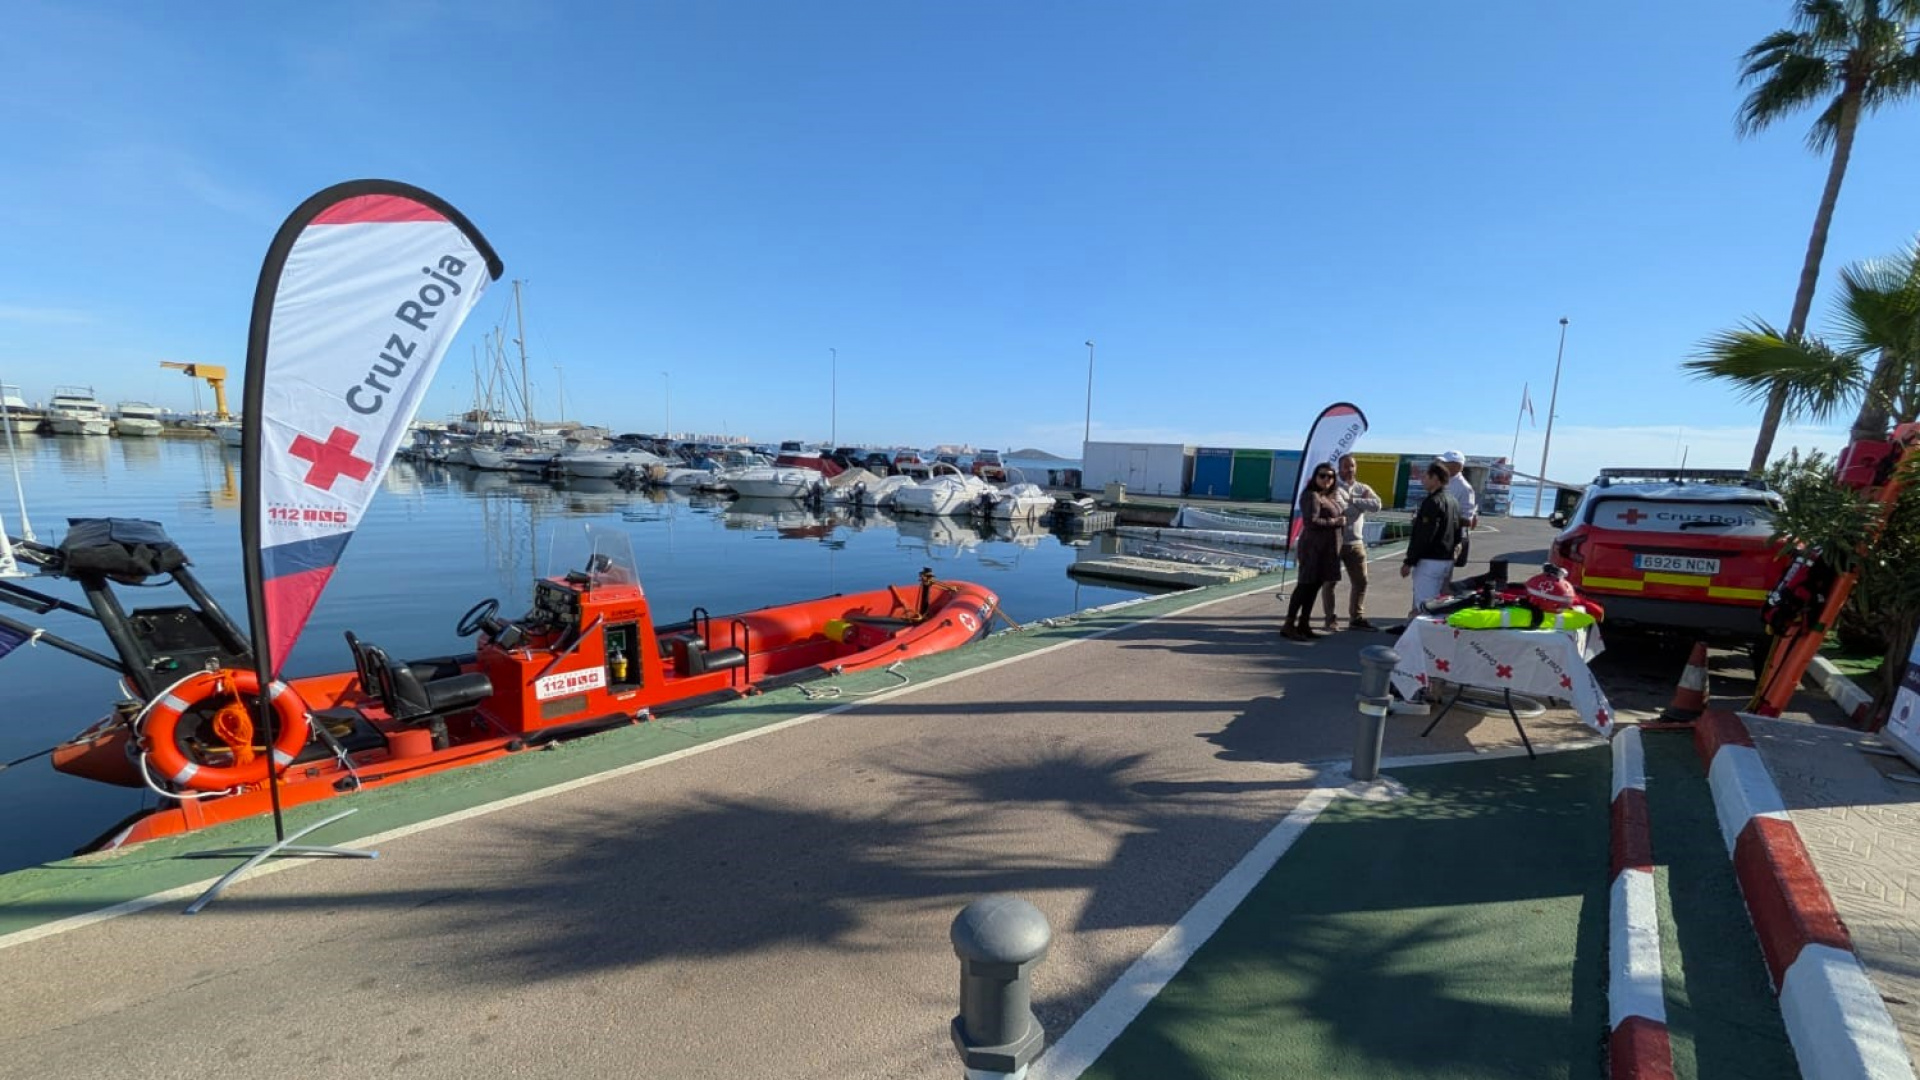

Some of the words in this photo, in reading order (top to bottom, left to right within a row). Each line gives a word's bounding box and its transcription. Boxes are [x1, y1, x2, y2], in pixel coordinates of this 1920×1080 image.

[346, 333, 417, 415] Cruz
[395, 254, 467, 332] Roja
[268, 508, 300, 520] 112
[1656, 512, 1702, 522] Cruz
[1644, 557, 1681, 569] 6926
[1685, 560, 1716, 573] NCN
[543, 680, 565, 692] 112
